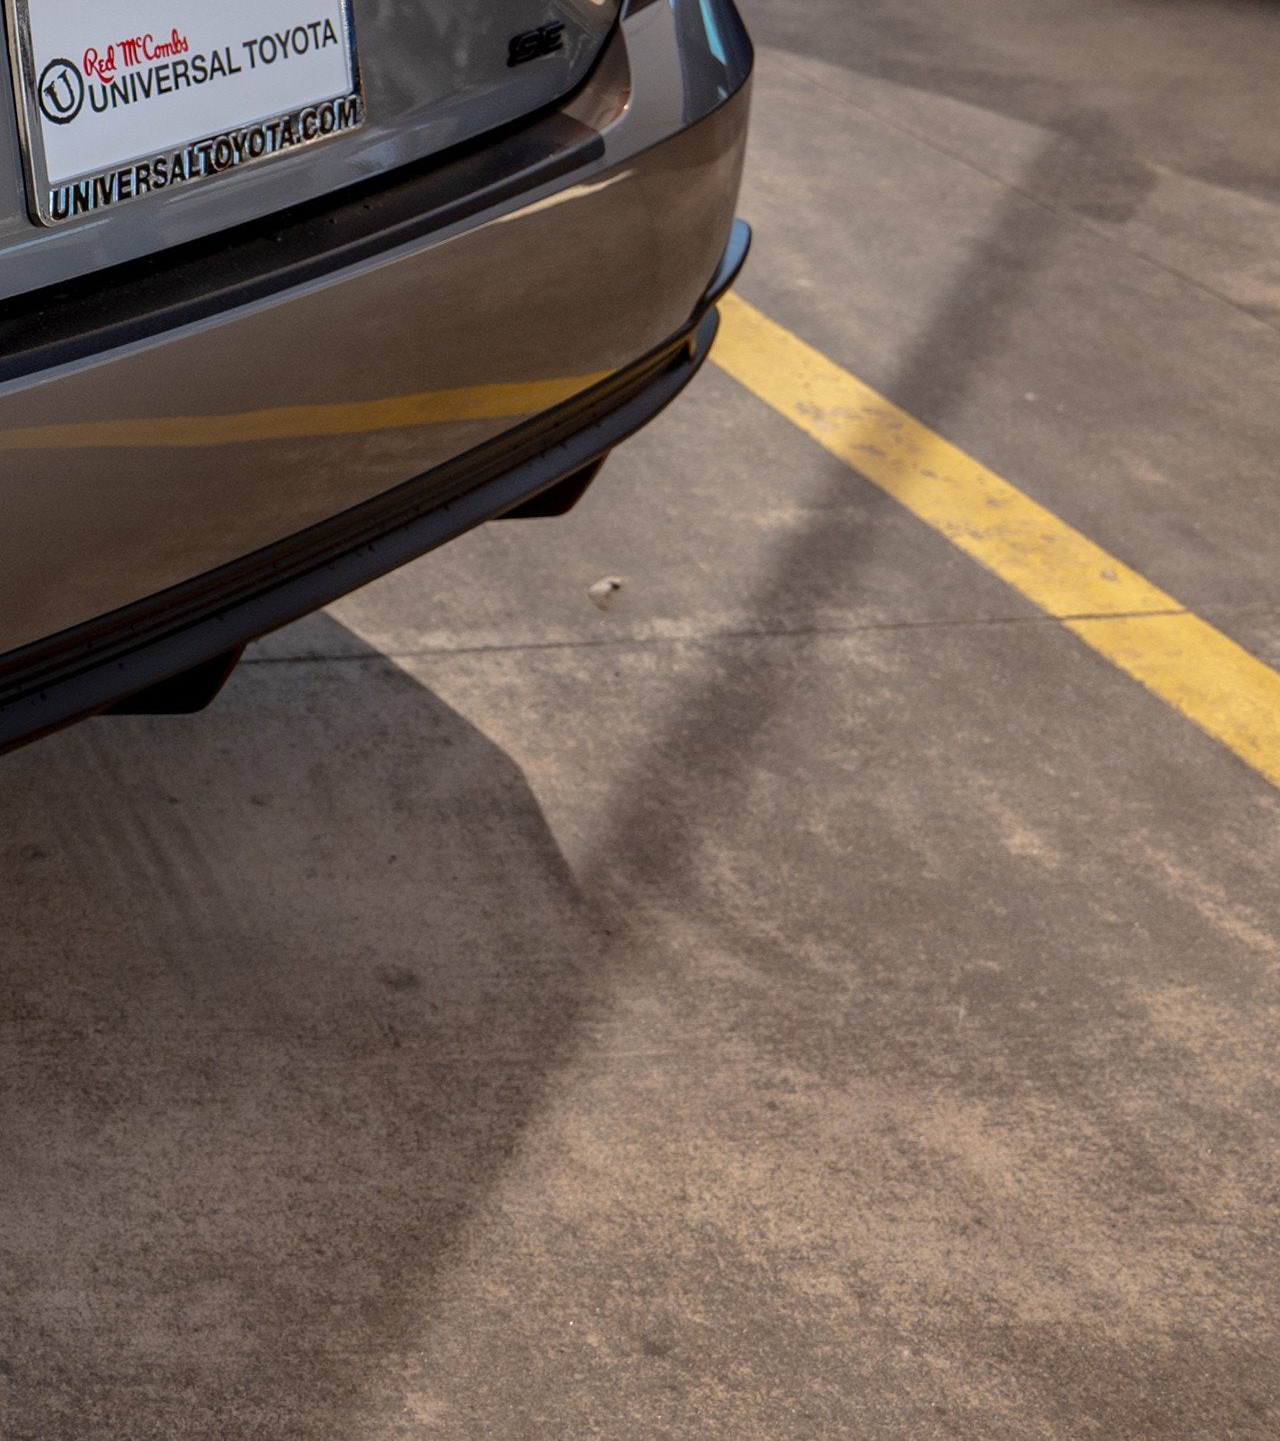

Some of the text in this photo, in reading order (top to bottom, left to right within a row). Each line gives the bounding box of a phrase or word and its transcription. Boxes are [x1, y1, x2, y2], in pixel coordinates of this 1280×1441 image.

[83, 28, 189, 84] Red McCombs
[88, 18, 338, 113] UNIVERSAL TOYOTA
[49, 94, 359, 222] UNIVERSALTOYOTA.COM
